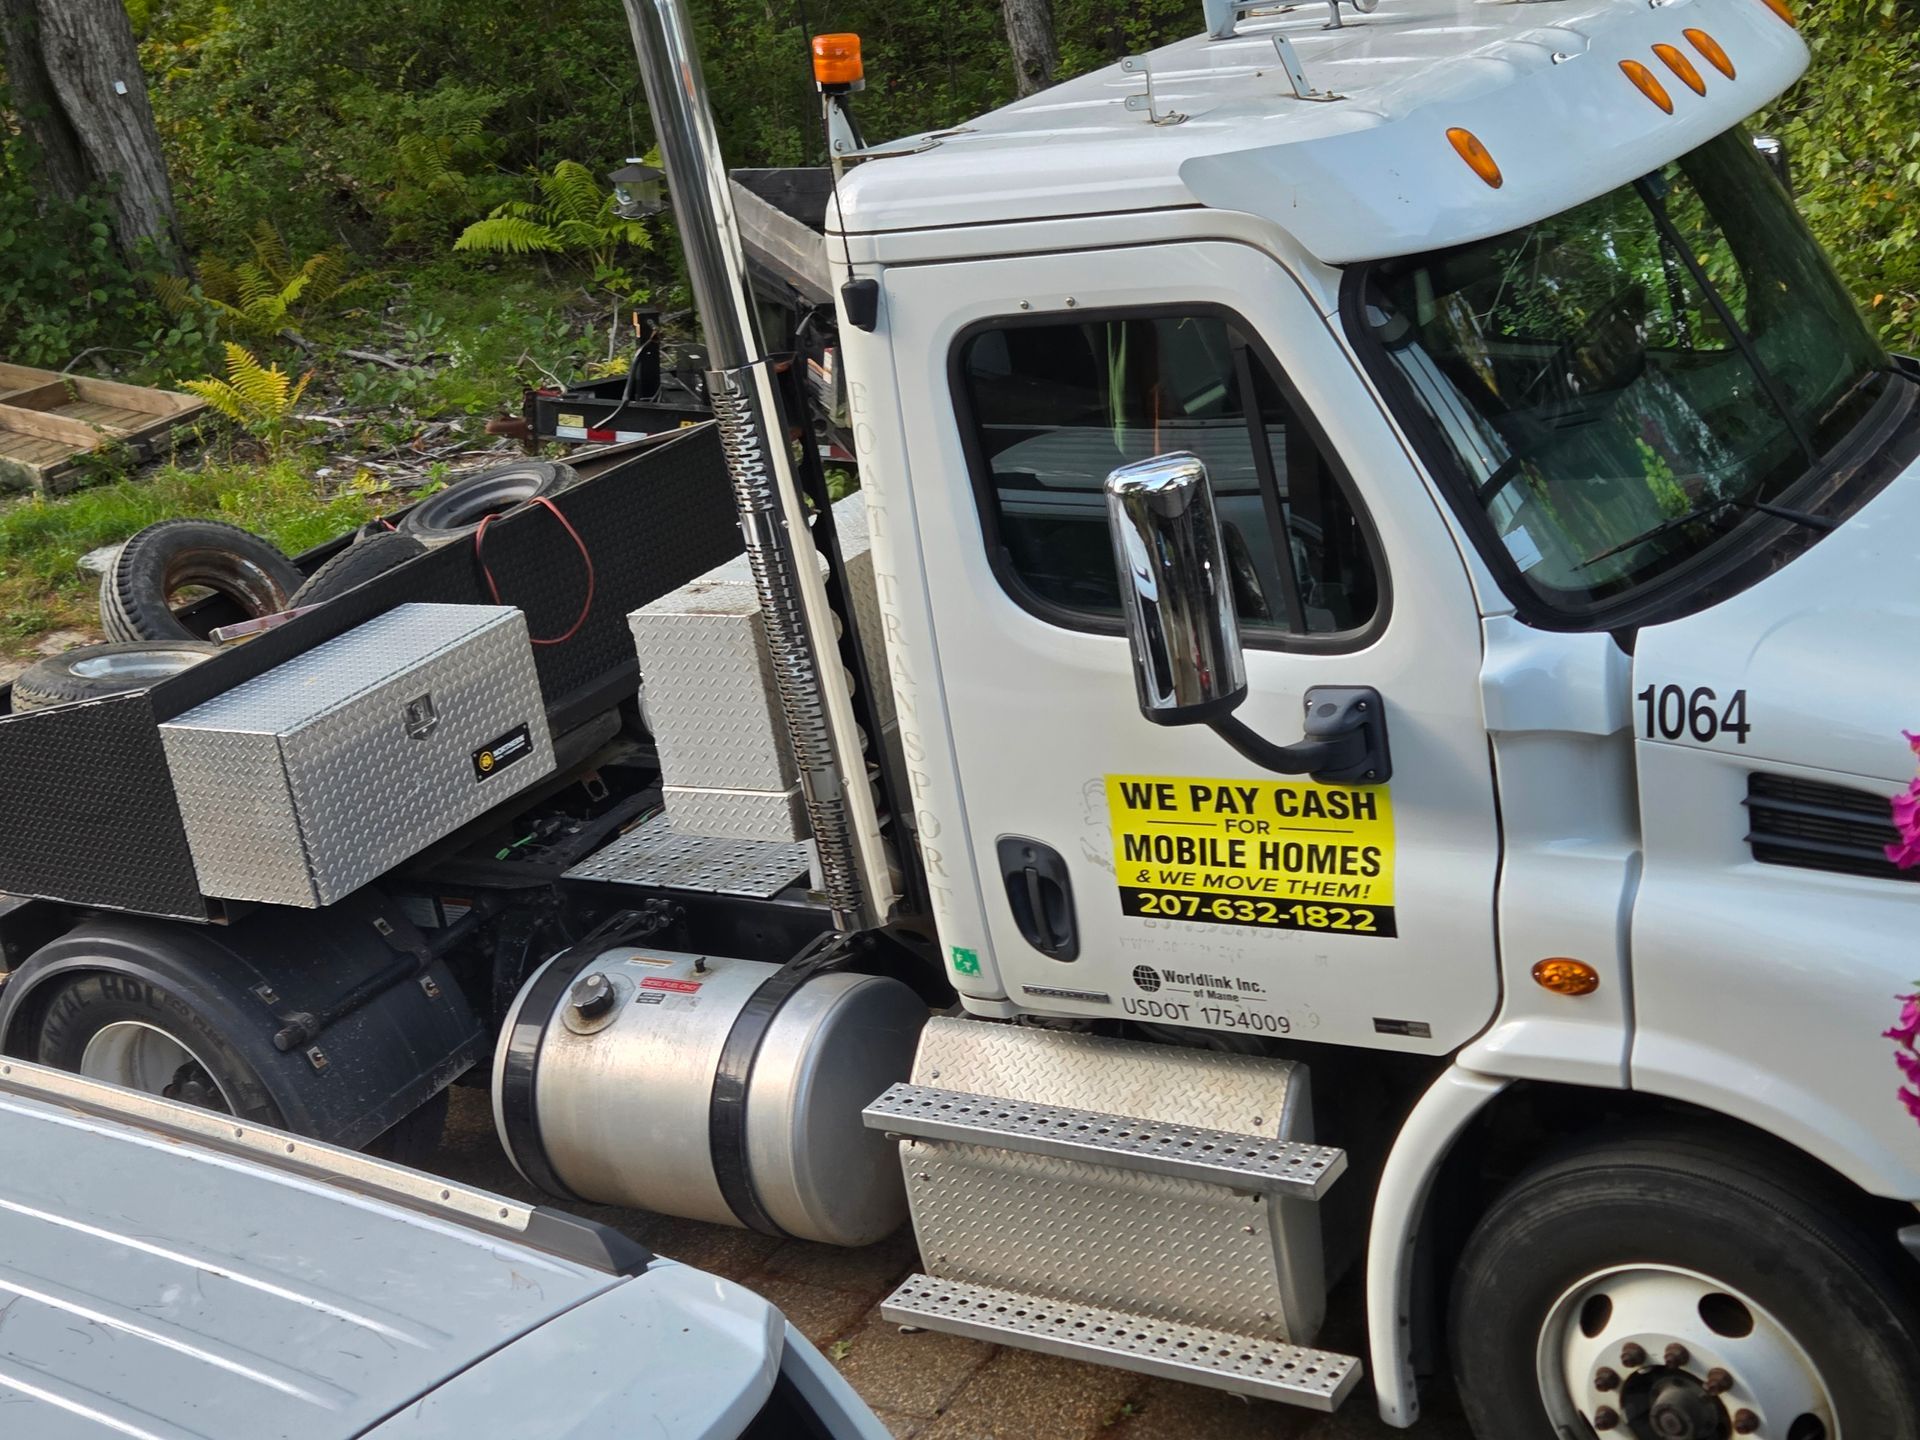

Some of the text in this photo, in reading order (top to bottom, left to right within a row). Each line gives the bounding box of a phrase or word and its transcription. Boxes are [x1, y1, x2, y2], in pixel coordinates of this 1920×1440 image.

[1637, 684, 1752, 744] 1064
[877, 572, 953, 915] TRANSPORT
[1119, 782, 1378, 821] WE PAY CASH
[1224, 818, 1271, 835] FOR
[1123, 833, 1382, 877] MOBILE HOMES
[1136, 869, 1372, 899] & WE MOVE THEM!
[1138, 892, 1378, 932] 207-632-1822
[1161, 969, 1267, 994] Worldlink Inc.
[1193, 988, 1240, 1002] of Maine
[1121, 997, 1191, 1021] USDOT
[1200, 1007, 1291, 1034] 1754009
